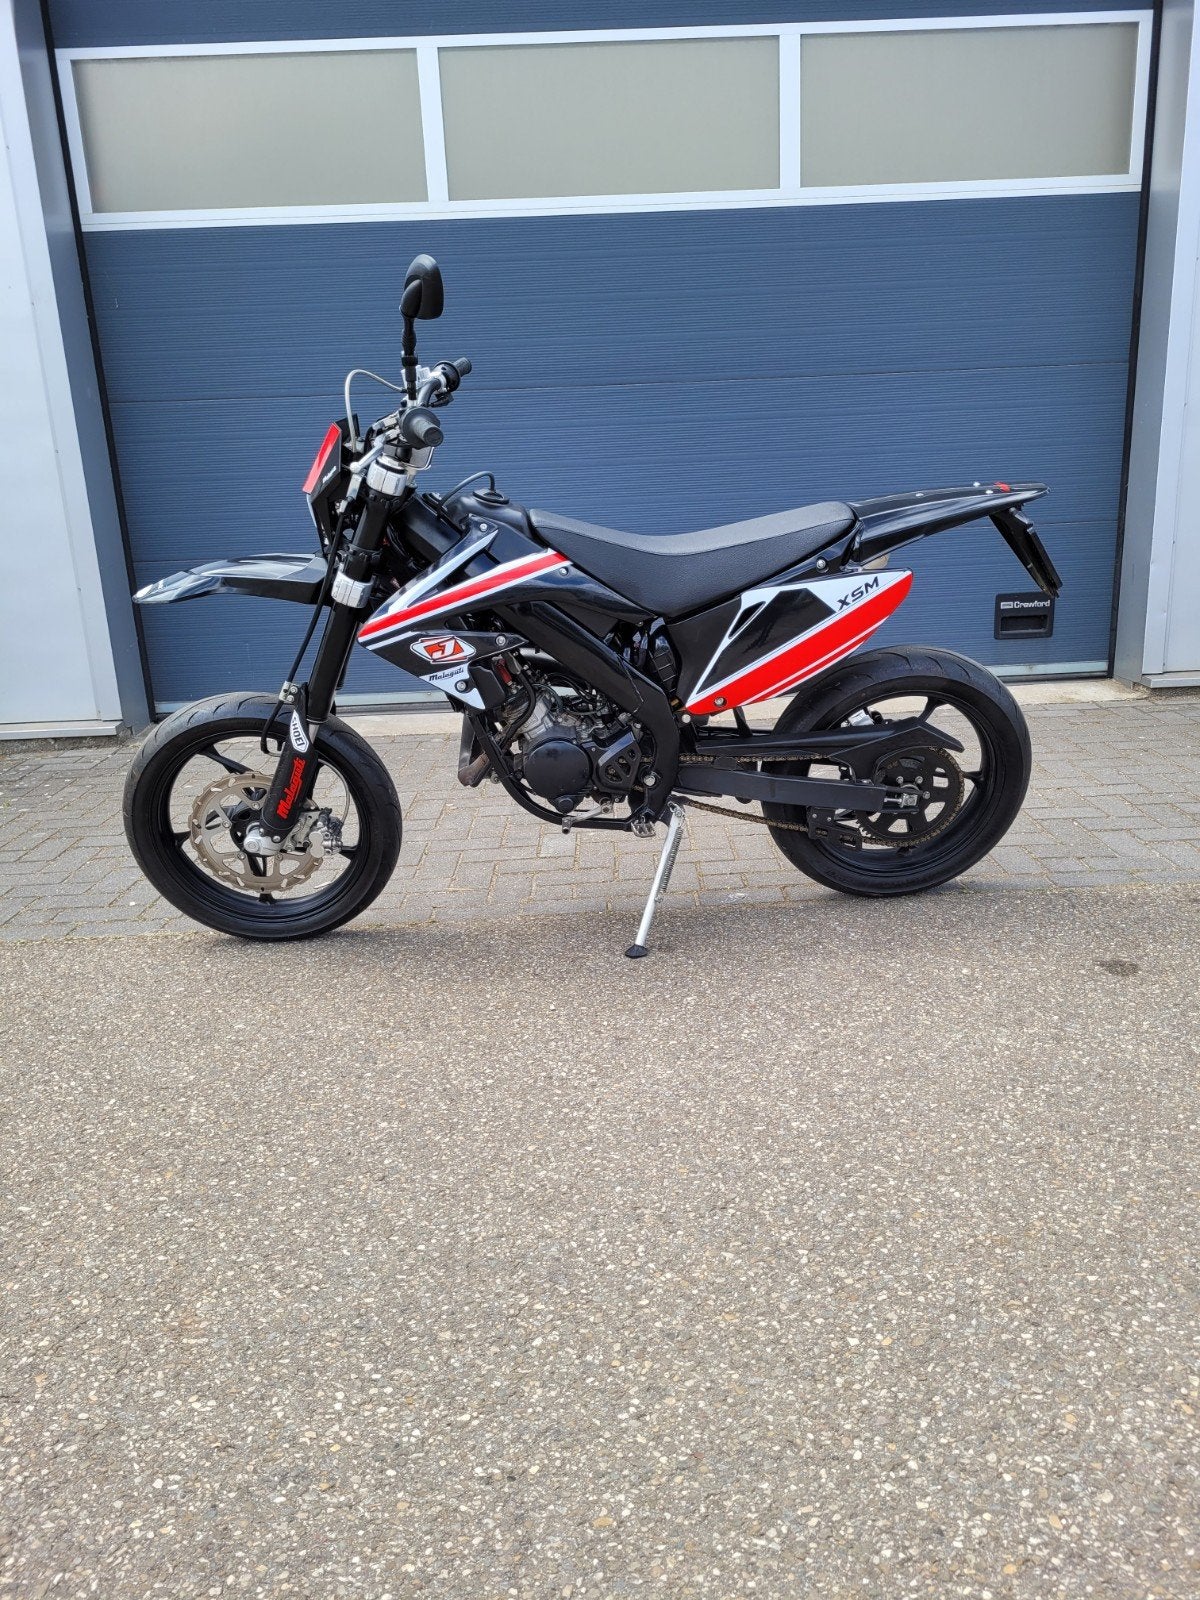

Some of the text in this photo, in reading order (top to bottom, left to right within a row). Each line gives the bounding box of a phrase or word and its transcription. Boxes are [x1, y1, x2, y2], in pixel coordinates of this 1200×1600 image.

[837, 576, 880, 611] XSM
[1014, 600, 1050, 609] Crawford
[429, 668, 464, 682] Malaguti
